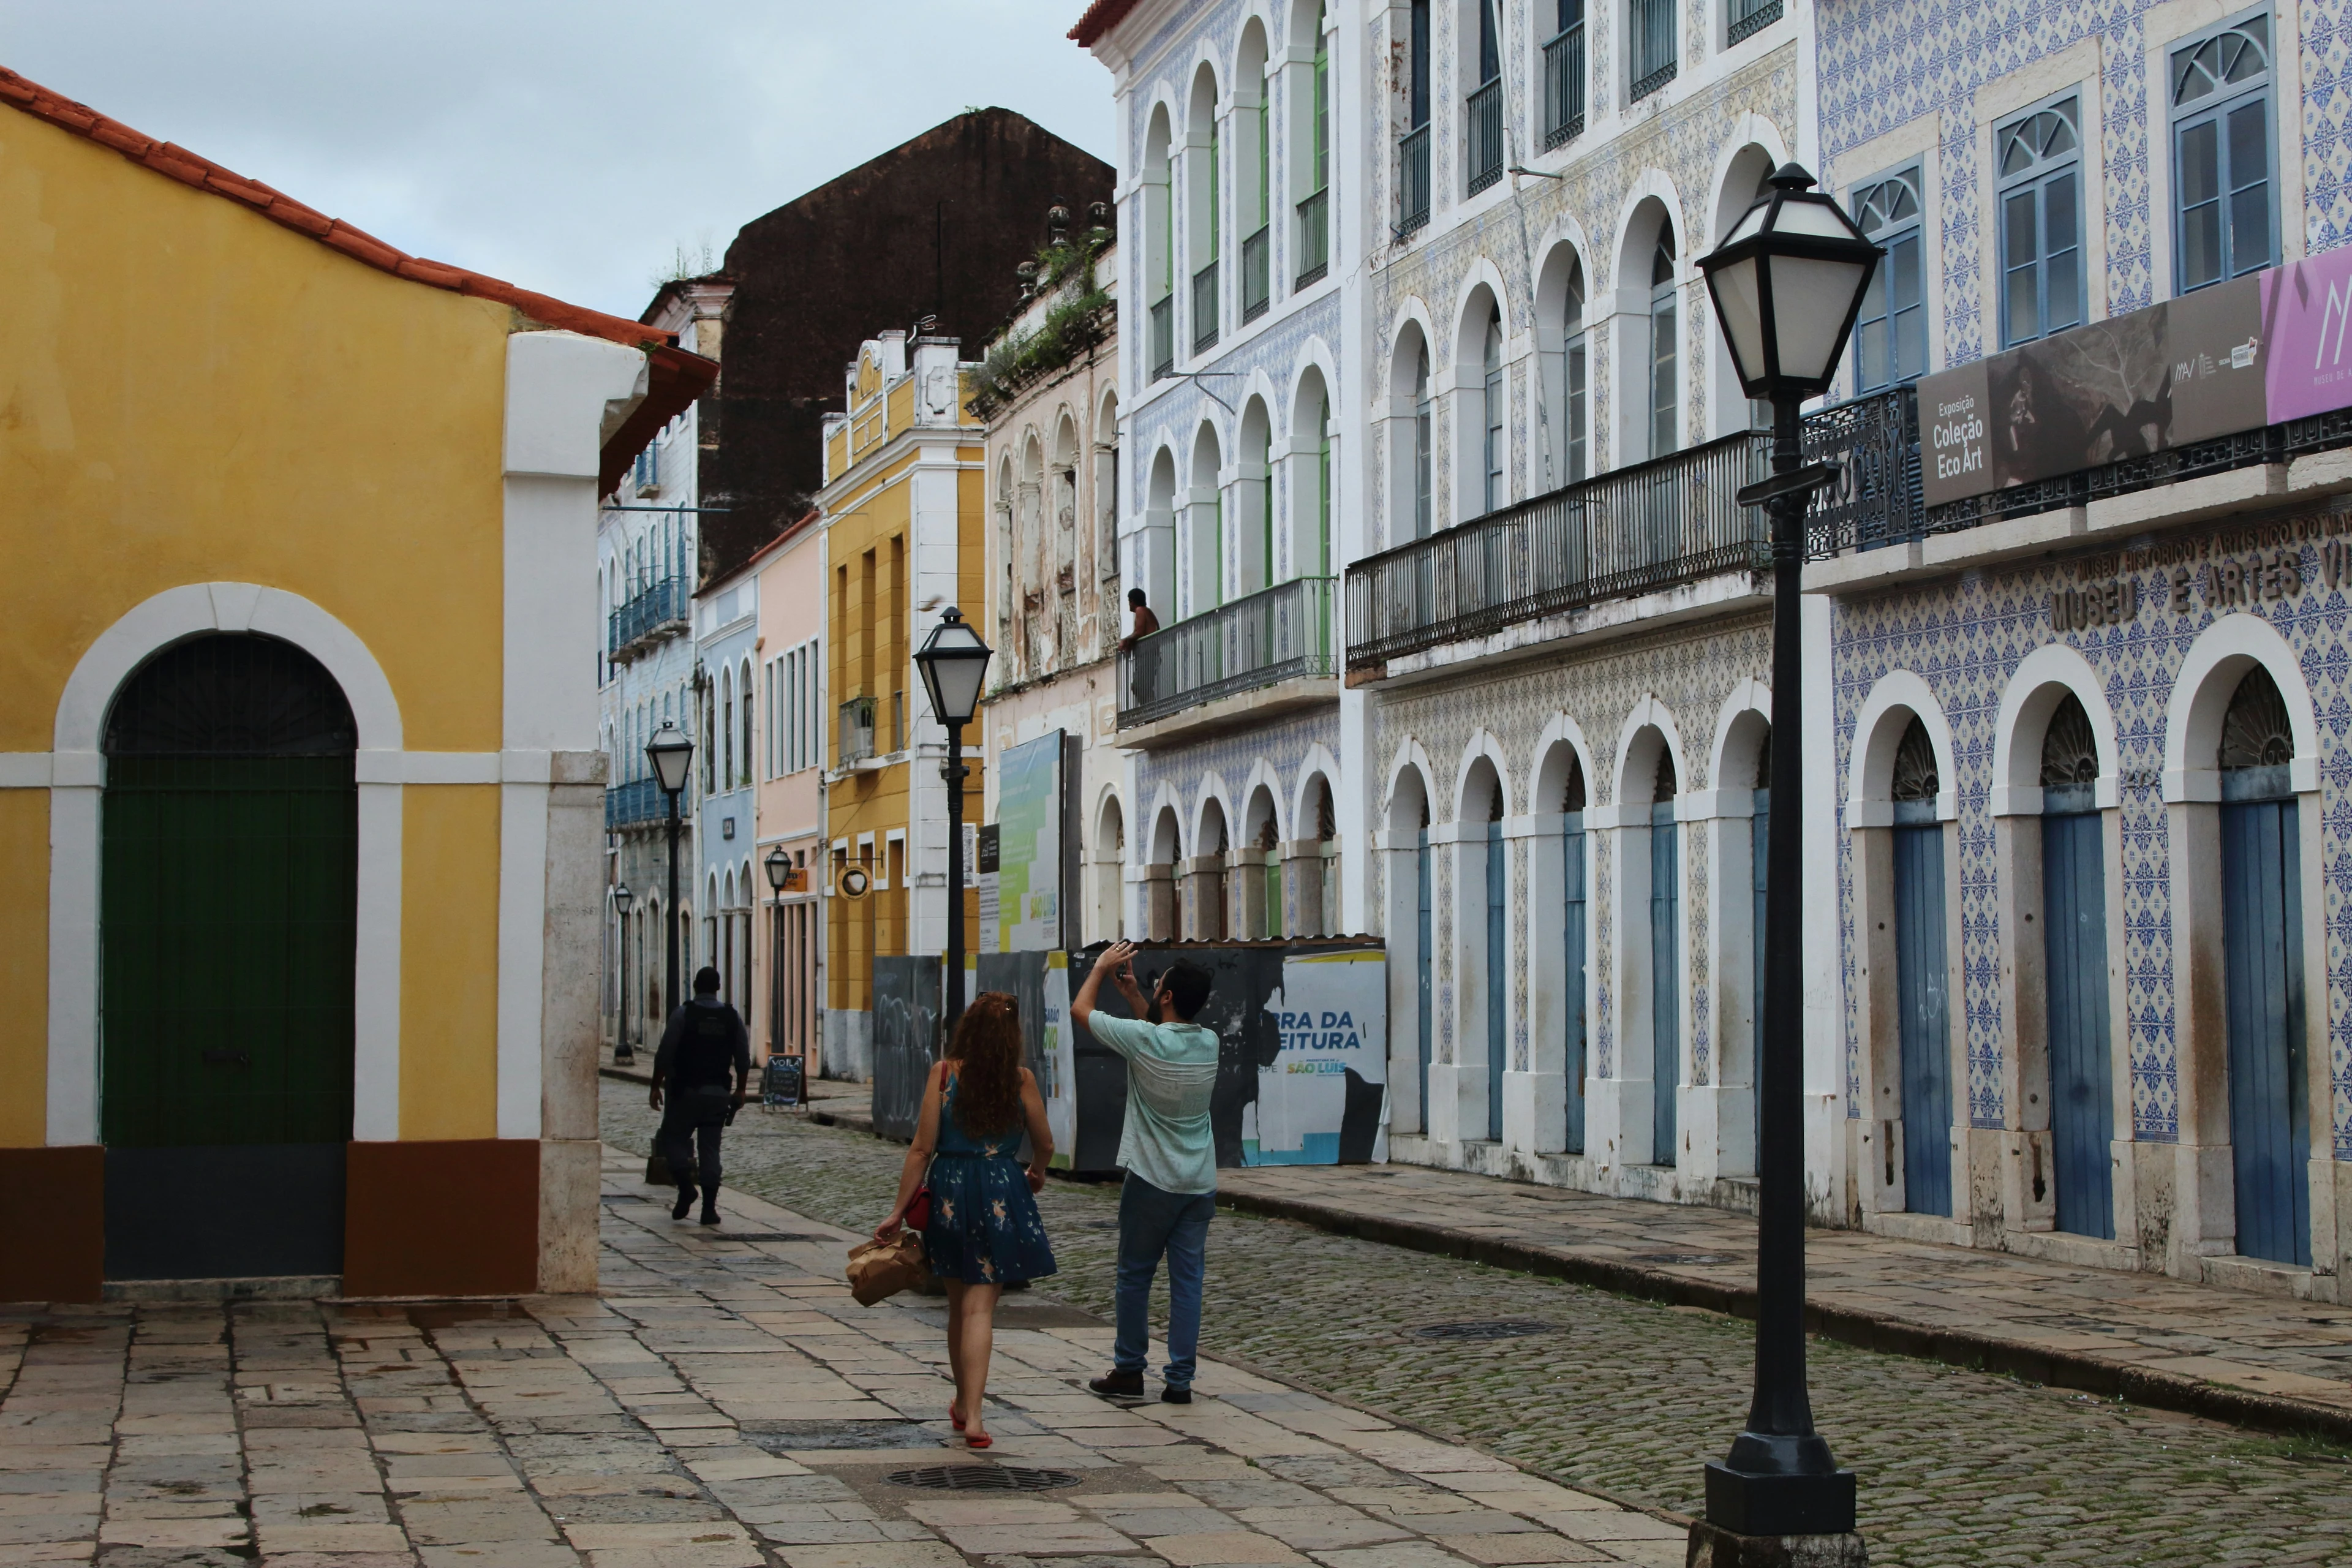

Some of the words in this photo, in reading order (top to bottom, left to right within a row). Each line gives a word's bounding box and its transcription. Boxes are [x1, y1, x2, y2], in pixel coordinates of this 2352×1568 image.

[2313, 373, 2333, 386] MUSEU
[2337, 369, 2345, 380] DE
[1939, 394, 1974, 418] Exposição
[1934, 413, 1983, 449] Coleção
[1937, 453, 1960, 479] Eco
[1962, 446, 1983, 473] Art
[2078, 556, 2119, 581] MUSEU
[2197, 538, 2209, 559] E
[2297, 518, 2319, 540] DO
[2050, 581, 2136, 631] MUSEU
[2171, 570, 2191, 612] E
[2204, 551, 2301, 608] ARTES
[1321, 1011, 1354, 1029] DA
[1287, 1060, 1316, 1074] SÃO
[1317, 1059, 1346, 1073] LUÍS
